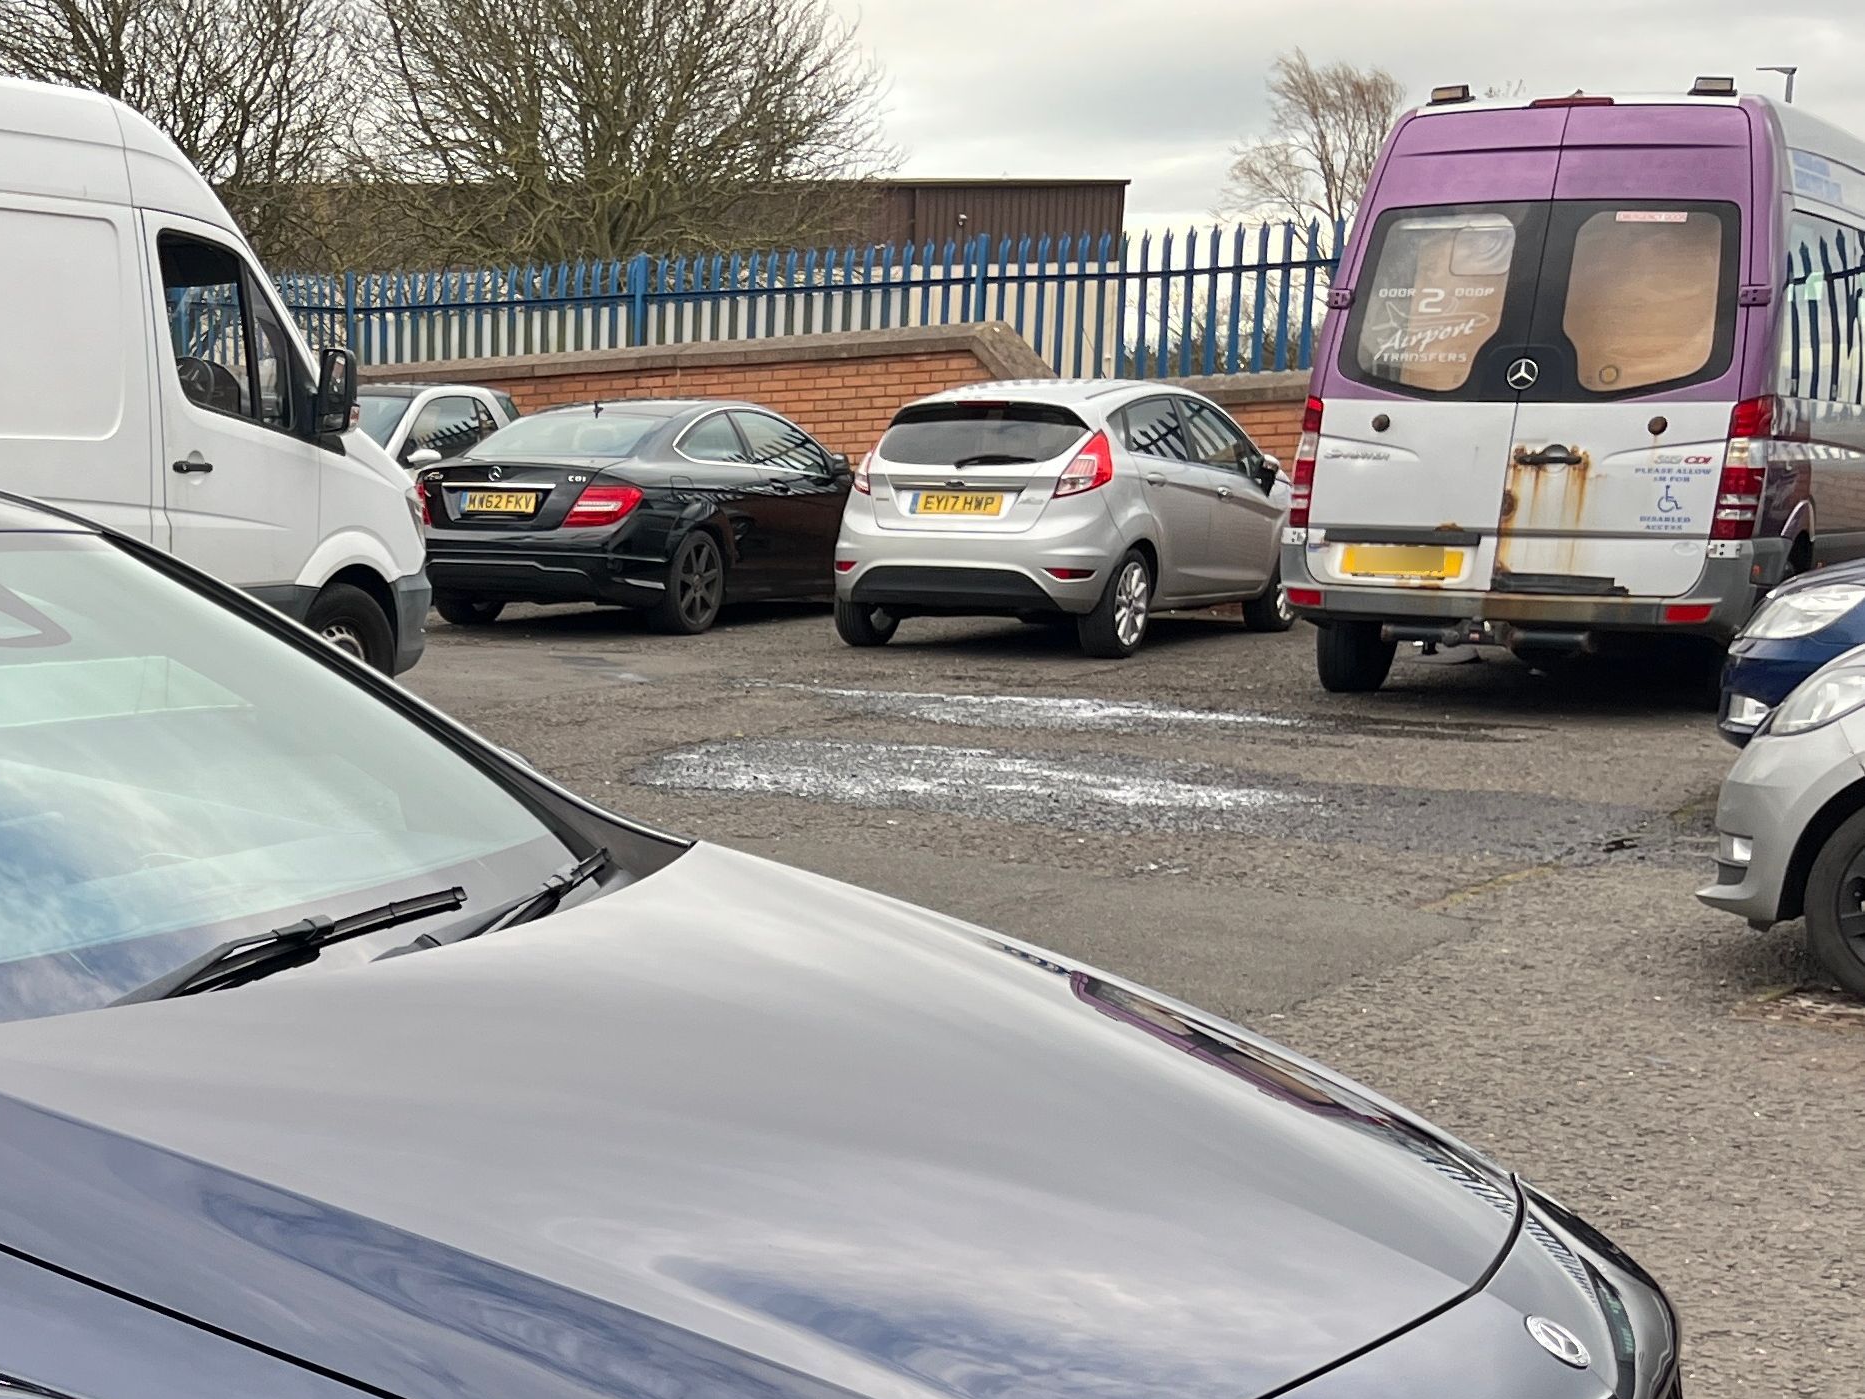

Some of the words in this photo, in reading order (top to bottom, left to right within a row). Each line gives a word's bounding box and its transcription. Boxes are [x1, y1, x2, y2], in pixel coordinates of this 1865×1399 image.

[1418, 287, 1445, 313] 2
[1373, 318, 1476, 361] Airport
[1382, 351, 1467, 362] TRANSFERS
[1683, 455, 1712, 464] CDI
[1634, 467, 1673, 475] PLEASE
[1675, 467, 1712, 475] ALLOW
[504, 494, 534, 510] FKV
[923, 494, 960, 511] EY17
[962, 495, 995, 512] HWP
[1639, 515, 1691, 523] DISABLED
